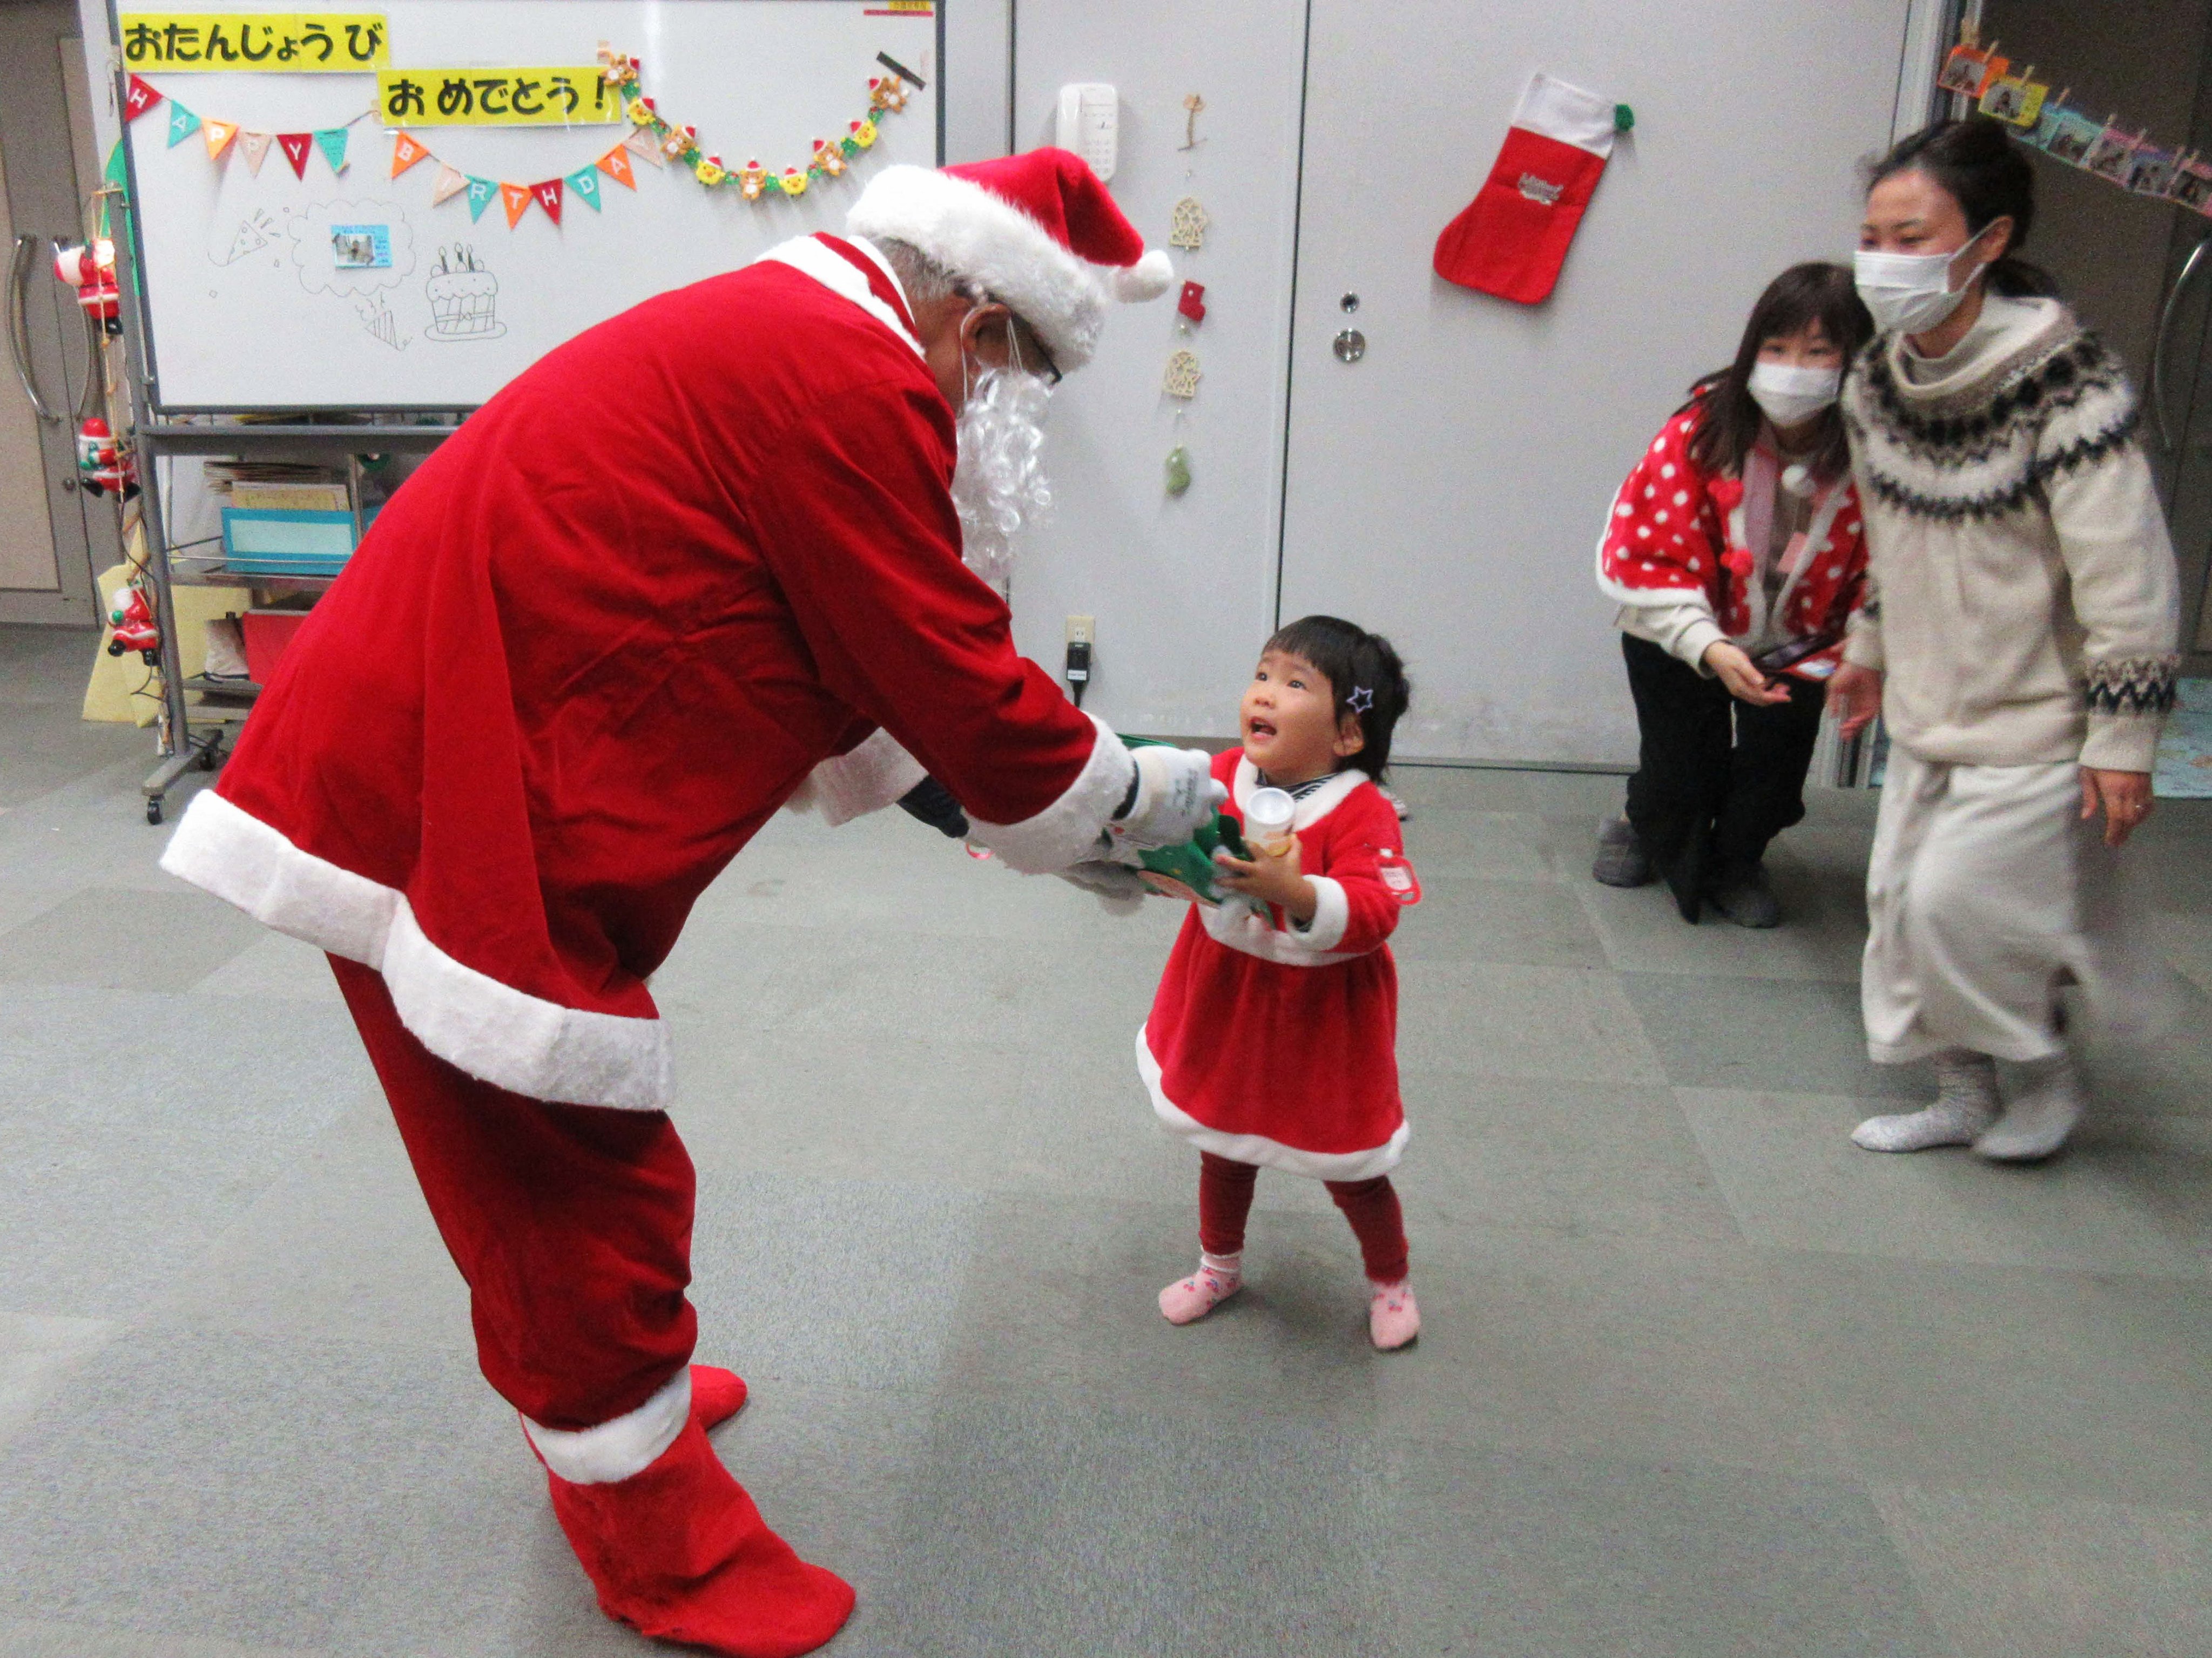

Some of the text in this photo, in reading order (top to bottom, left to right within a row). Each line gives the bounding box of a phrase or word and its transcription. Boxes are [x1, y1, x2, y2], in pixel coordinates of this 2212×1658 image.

[125, 22, 383, 62] おたんじょうび
